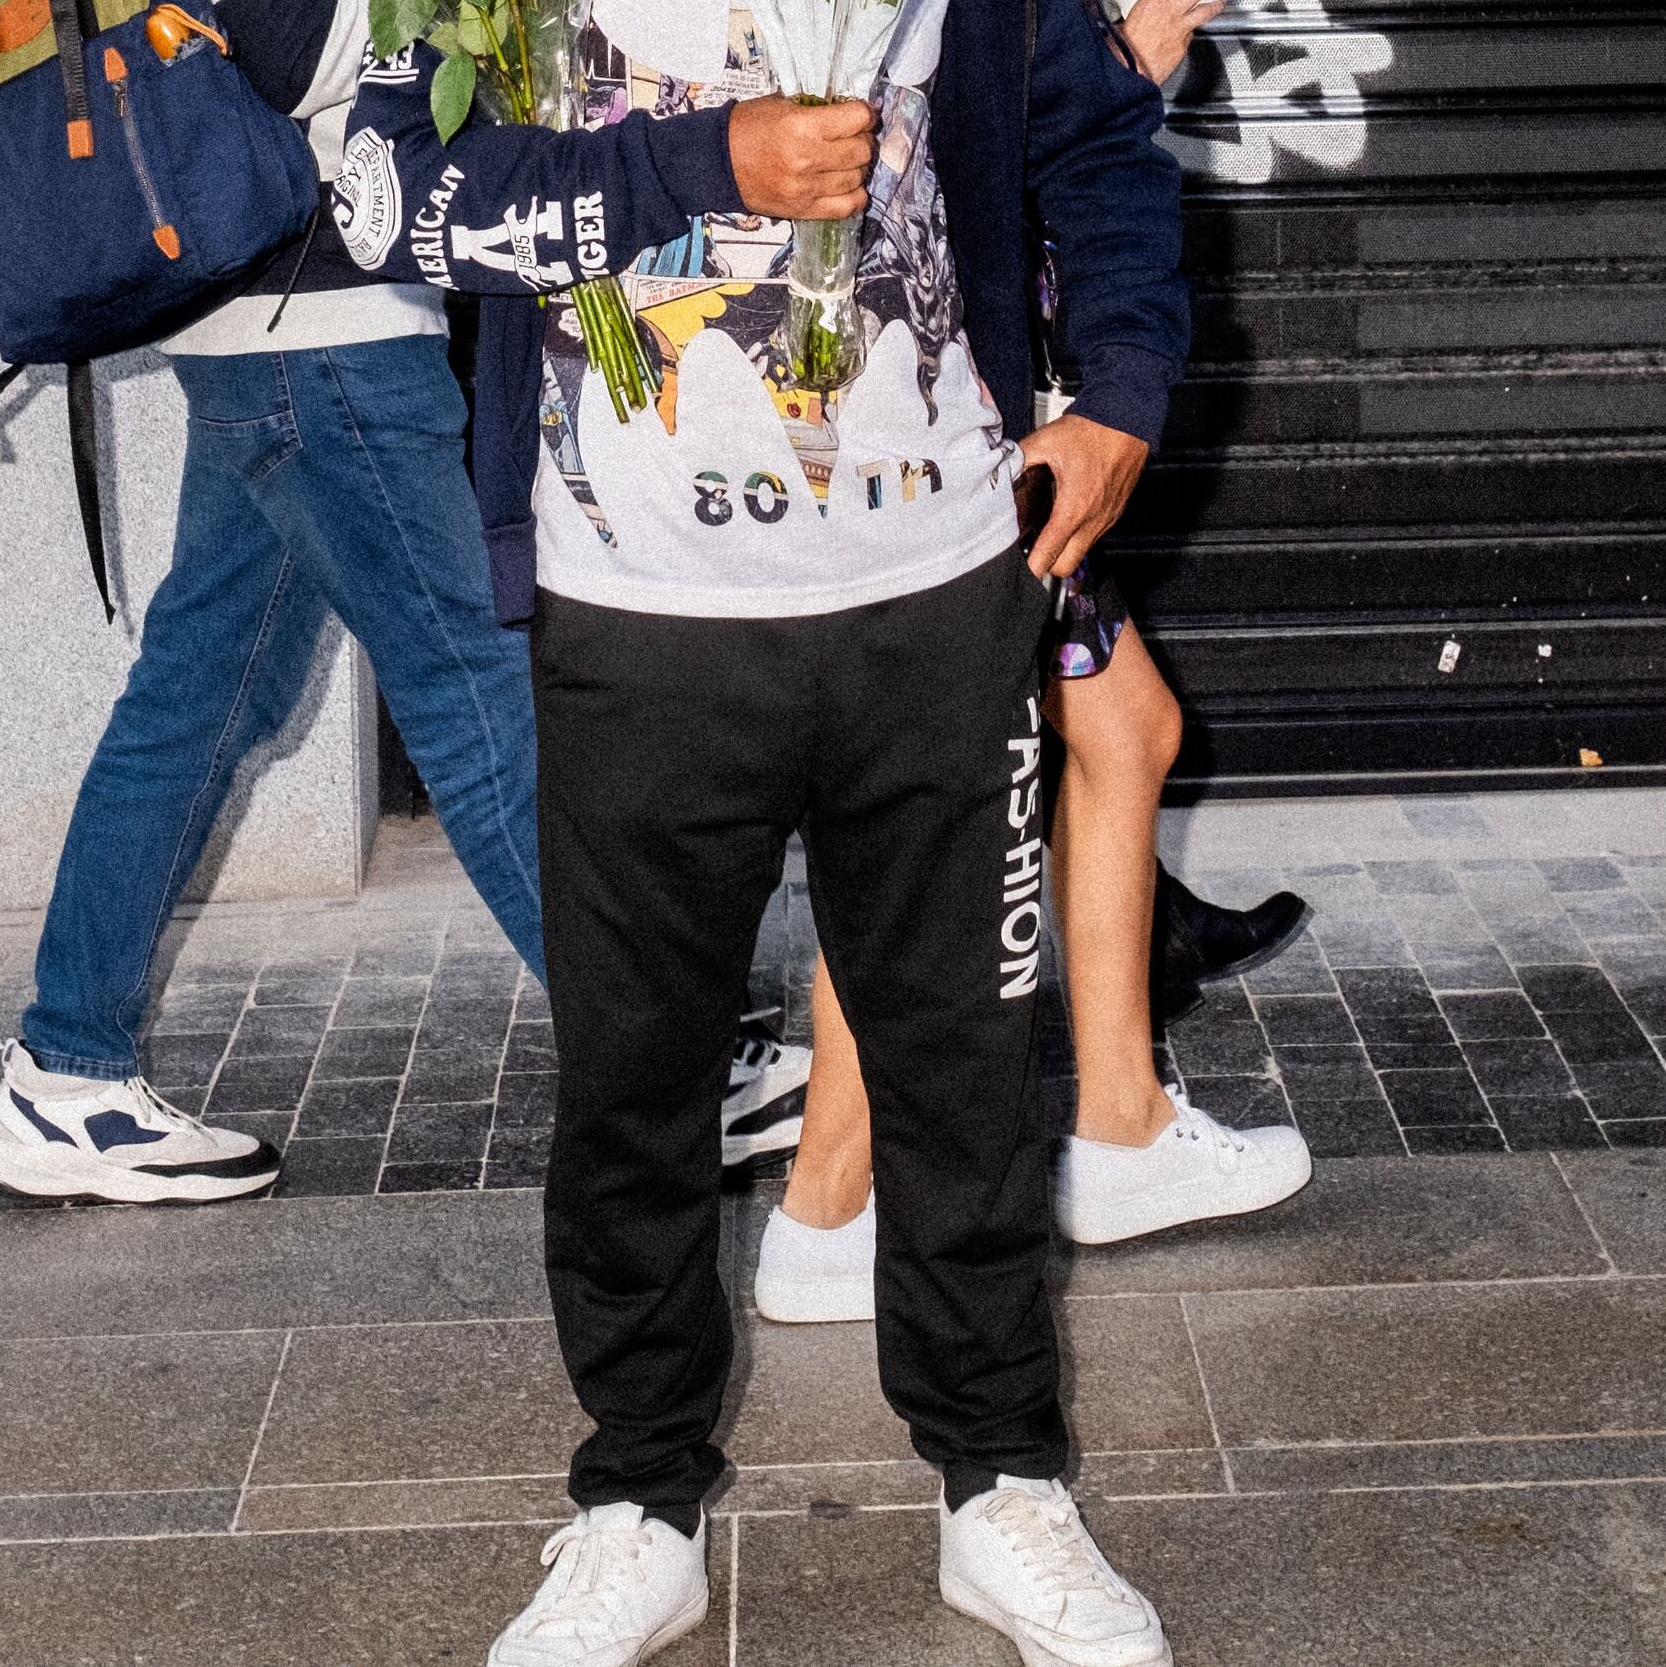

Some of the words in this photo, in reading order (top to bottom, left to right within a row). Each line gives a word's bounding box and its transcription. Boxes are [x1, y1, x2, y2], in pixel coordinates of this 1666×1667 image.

[410, 164, 466, 291] MERICAN
[514, 235, 531, 269] 1985
[574, 191, 610, 280] IGER
